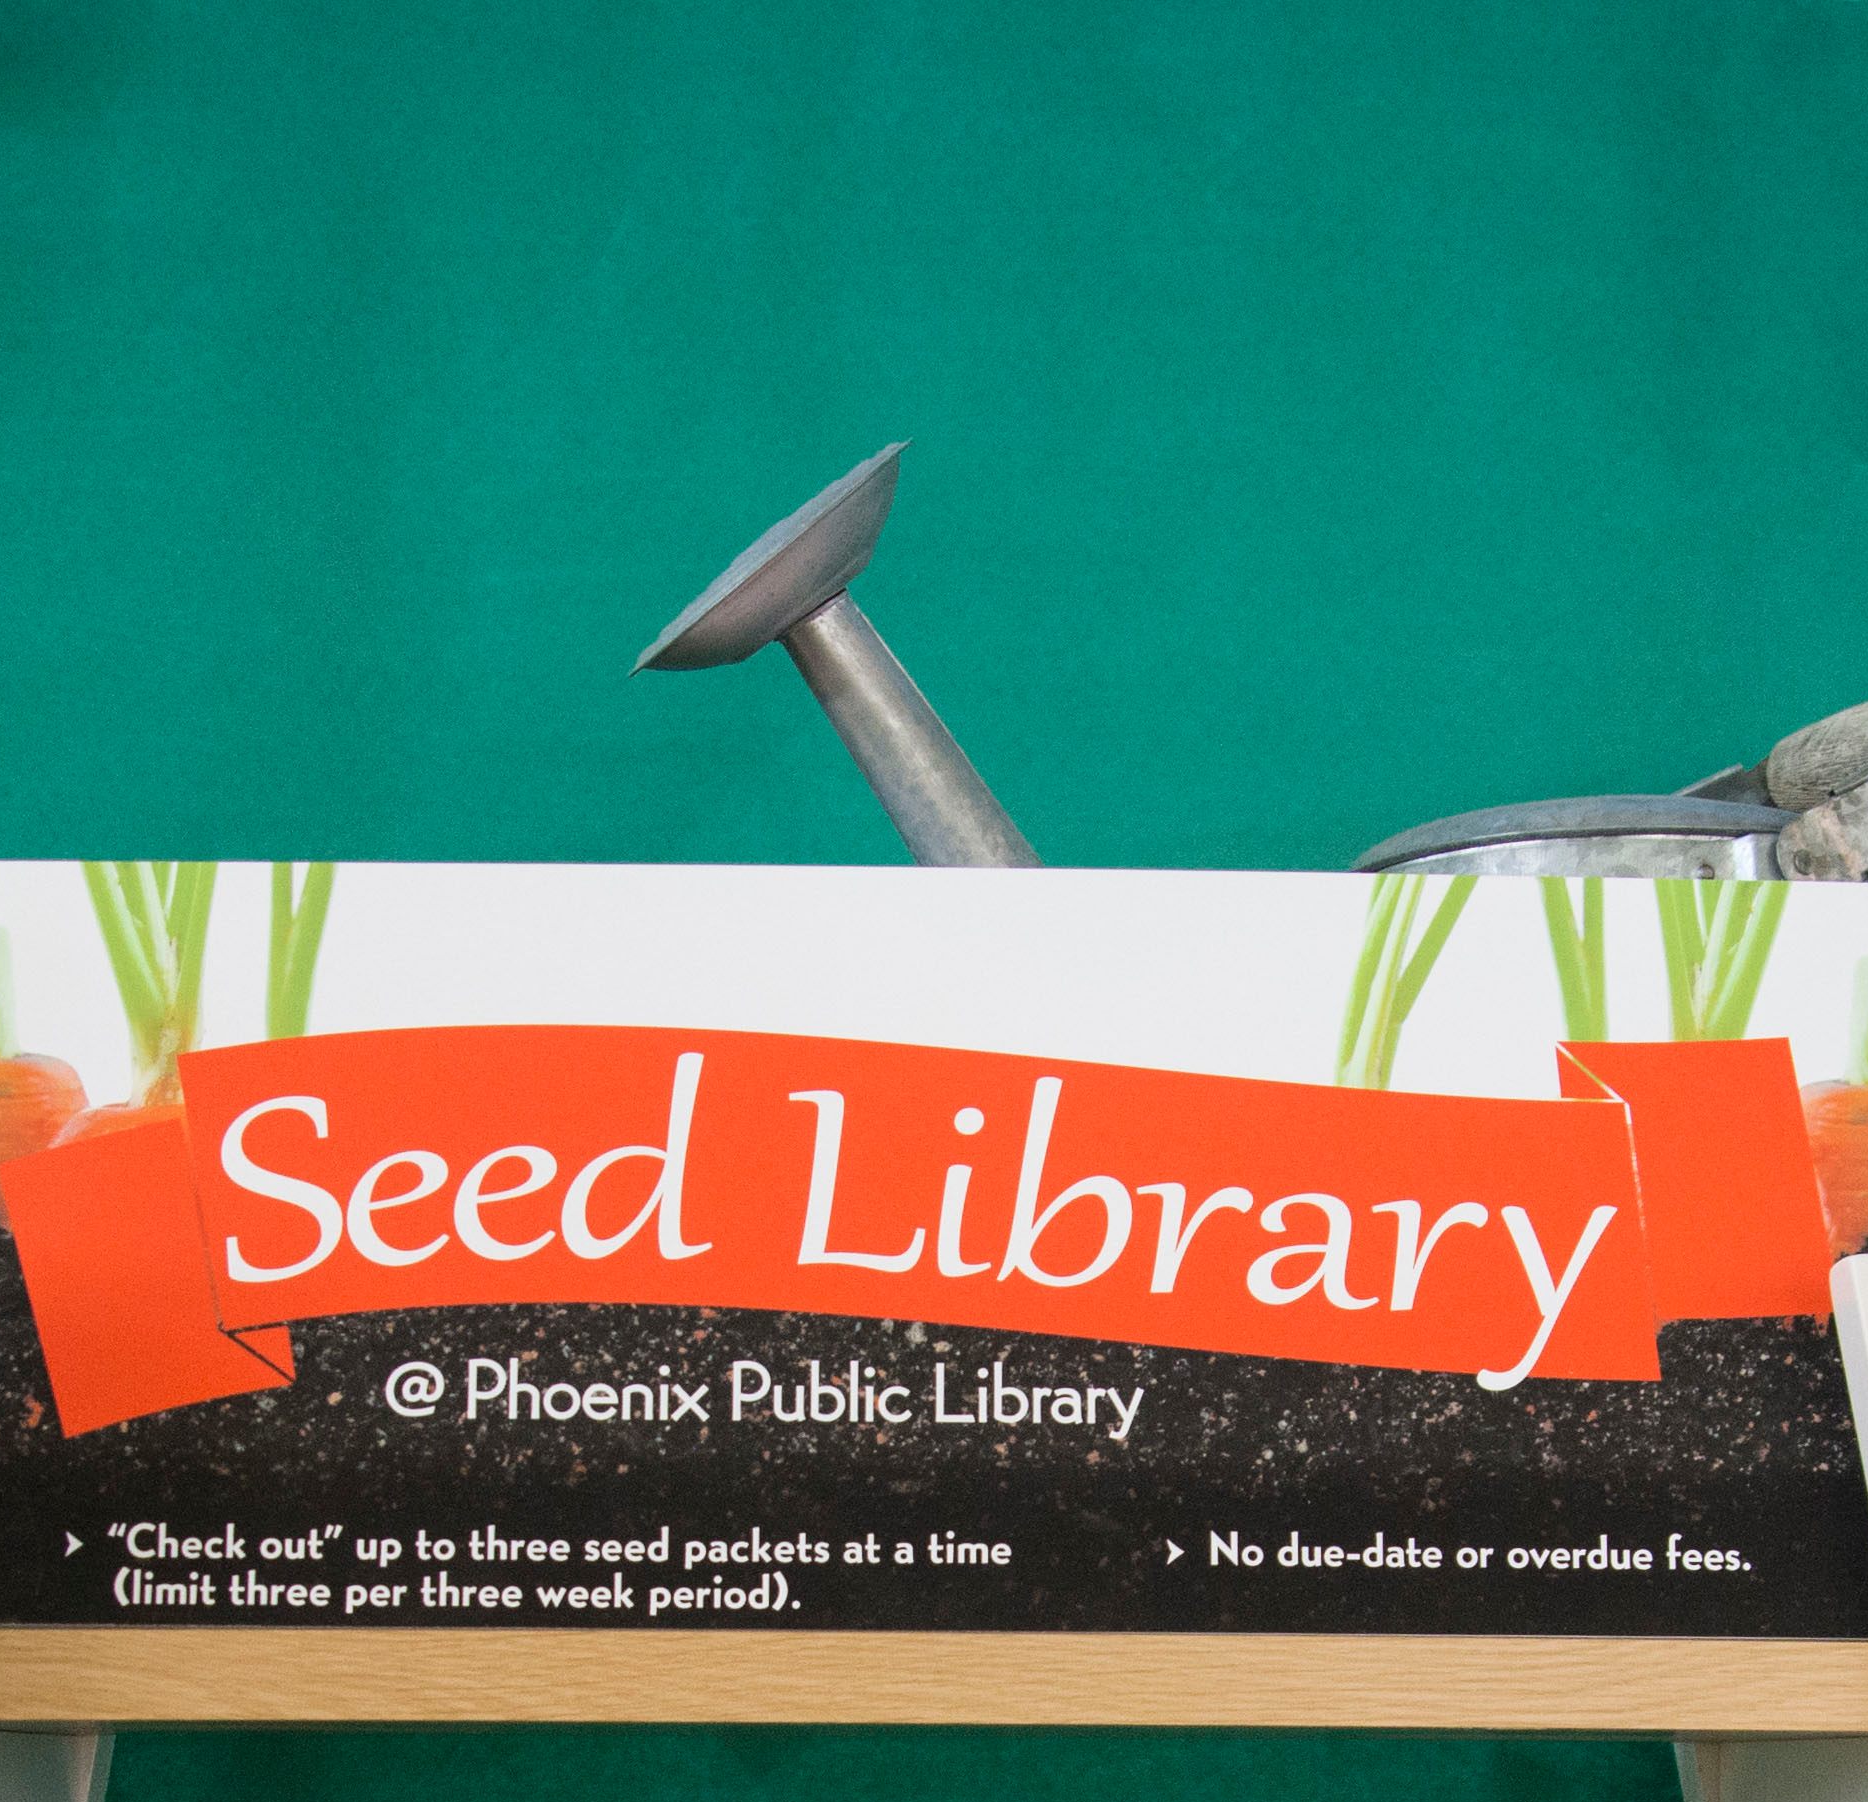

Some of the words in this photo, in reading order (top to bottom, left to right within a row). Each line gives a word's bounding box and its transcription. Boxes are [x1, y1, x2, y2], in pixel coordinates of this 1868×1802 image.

[218, 1053, 714, 1283] Seed
[785, 1076, 1619, 1391] Library
[386, 1361, 445, 1417] @
[467, 1358, 710, 1422] Phoenix
[733, 1360, 912, 1423] Public
[935, 1361, 1144, 1440] Library
[356, 1536, 401, 1567] up
[416, 1530, 455, 1561] to
[470, 1525, 570, 1562] three
[585, 1526, 669, 1563] seed
[684, 1527, 830, 1570] packets
[843, 1533, 881, 1564] at
[894, 1539, 914, 1565] a
[928, 1531, 1012, 1565] time
[1209, 1530, 1264, 1567] No
[1277, 1531, 1443, 1569] due-date
[1456, 1544, 1494, 1569] or
[1508, 1534, 1652, 1571] overdue
[1665, 1534, 1751, 1572] fees.
[114, 1567, 216, 1606] (limit
[229, 1569, 331, 1607] three
[345, 1583, 407, 1614] per
[421, 1570, 522, 1608] three
[537, 1571, 634, 1609] week
[649, 1571, 801, 1616] period).
